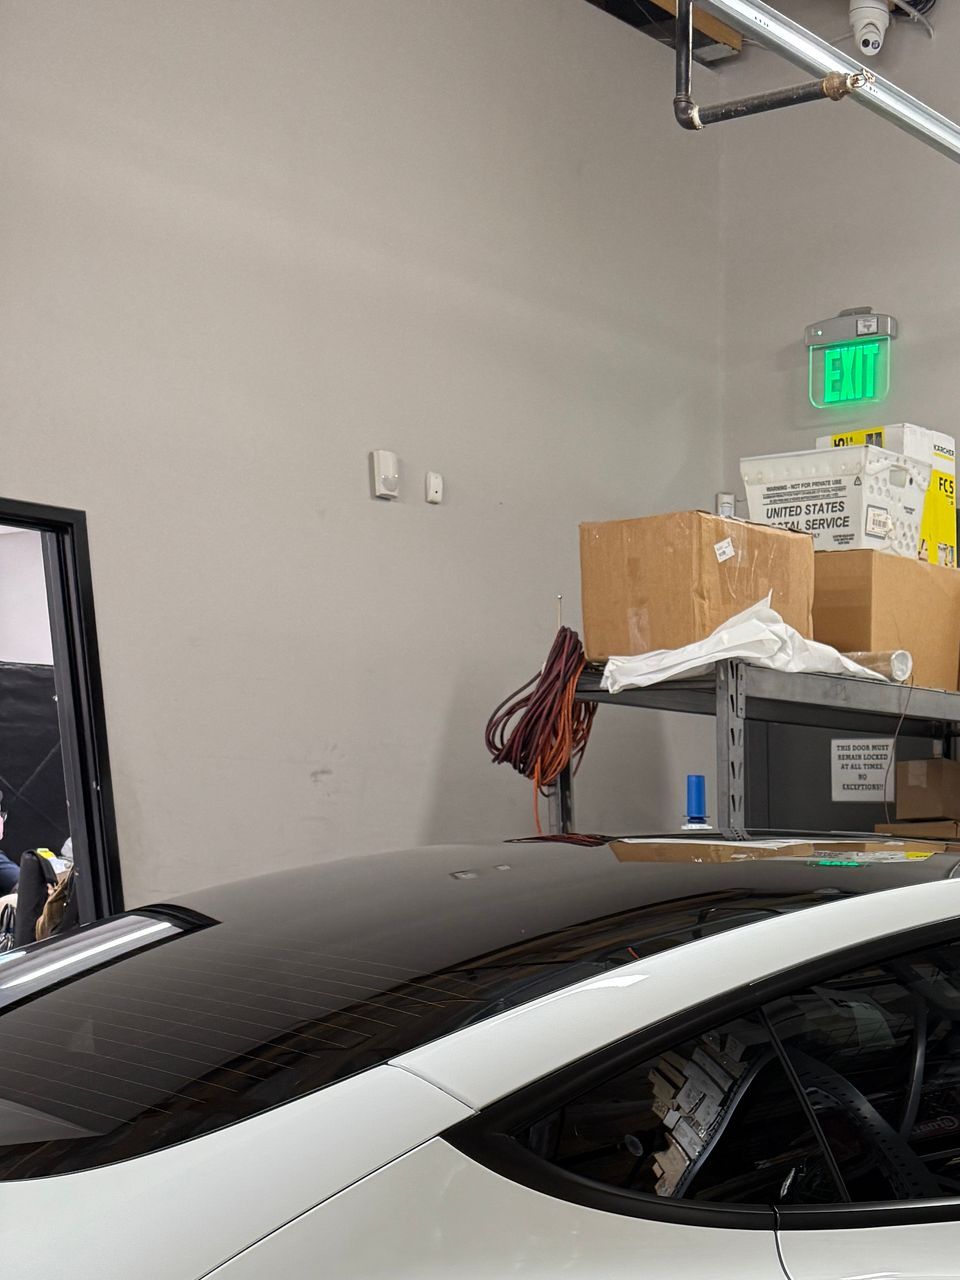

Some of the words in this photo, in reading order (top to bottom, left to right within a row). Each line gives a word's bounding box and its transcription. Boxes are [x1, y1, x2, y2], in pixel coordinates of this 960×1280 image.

[824, 343, 879, 403] EXIT
[766, 505, 802, 519] UNITED
[804, 501, 845, 515] STATES
[805, 516, 850, 530] SERVICE
